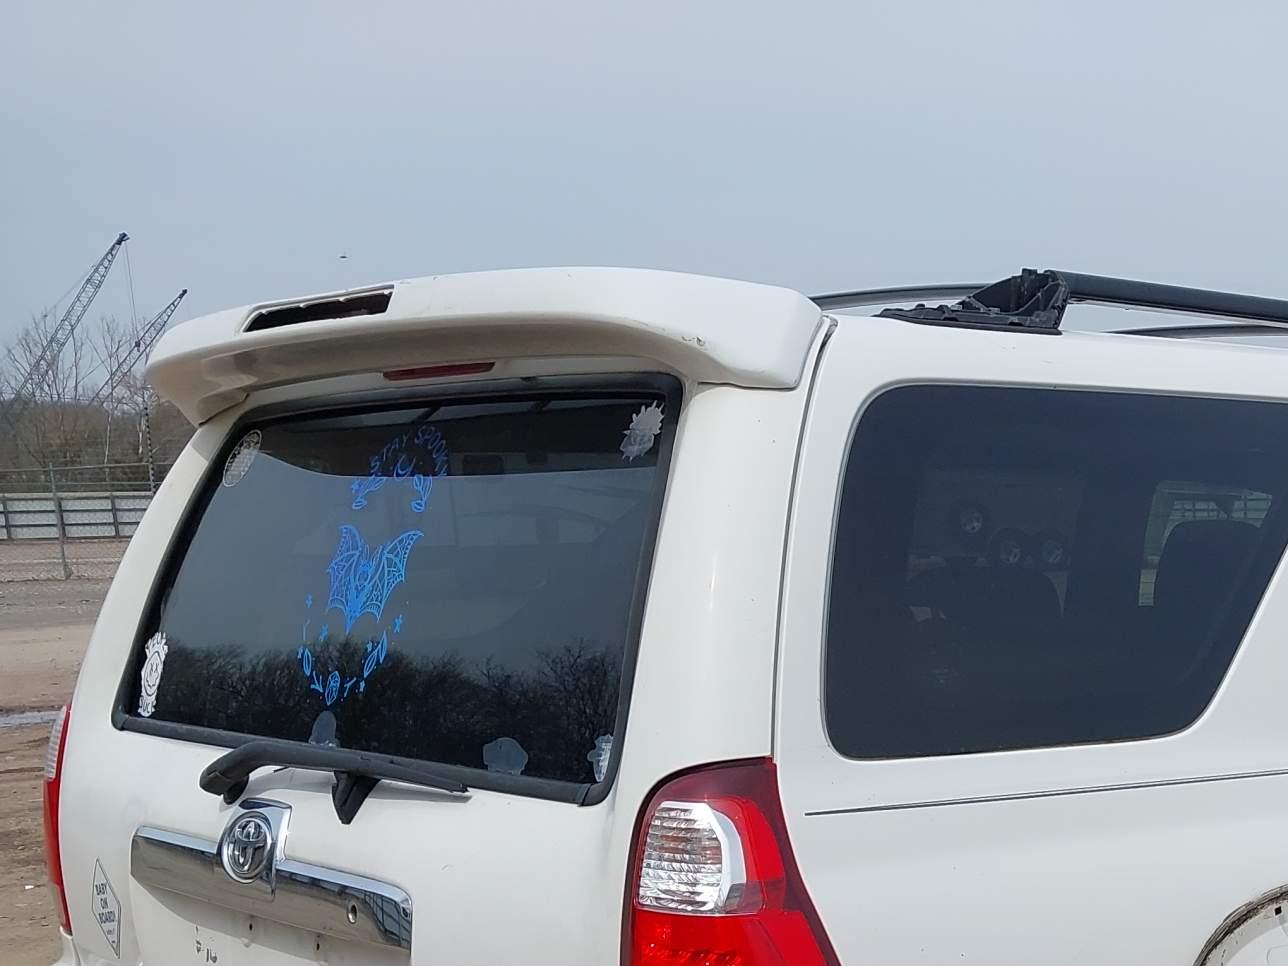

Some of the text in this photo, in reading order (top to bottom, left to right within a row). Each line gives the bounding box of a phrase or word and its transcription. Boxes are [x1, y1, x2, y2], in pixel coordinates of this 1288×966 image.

[369, 425, 448, 476] STAY SPOOKY
[95, 883, 108, 896] BABY
[100, 897, 108, 909] ON
